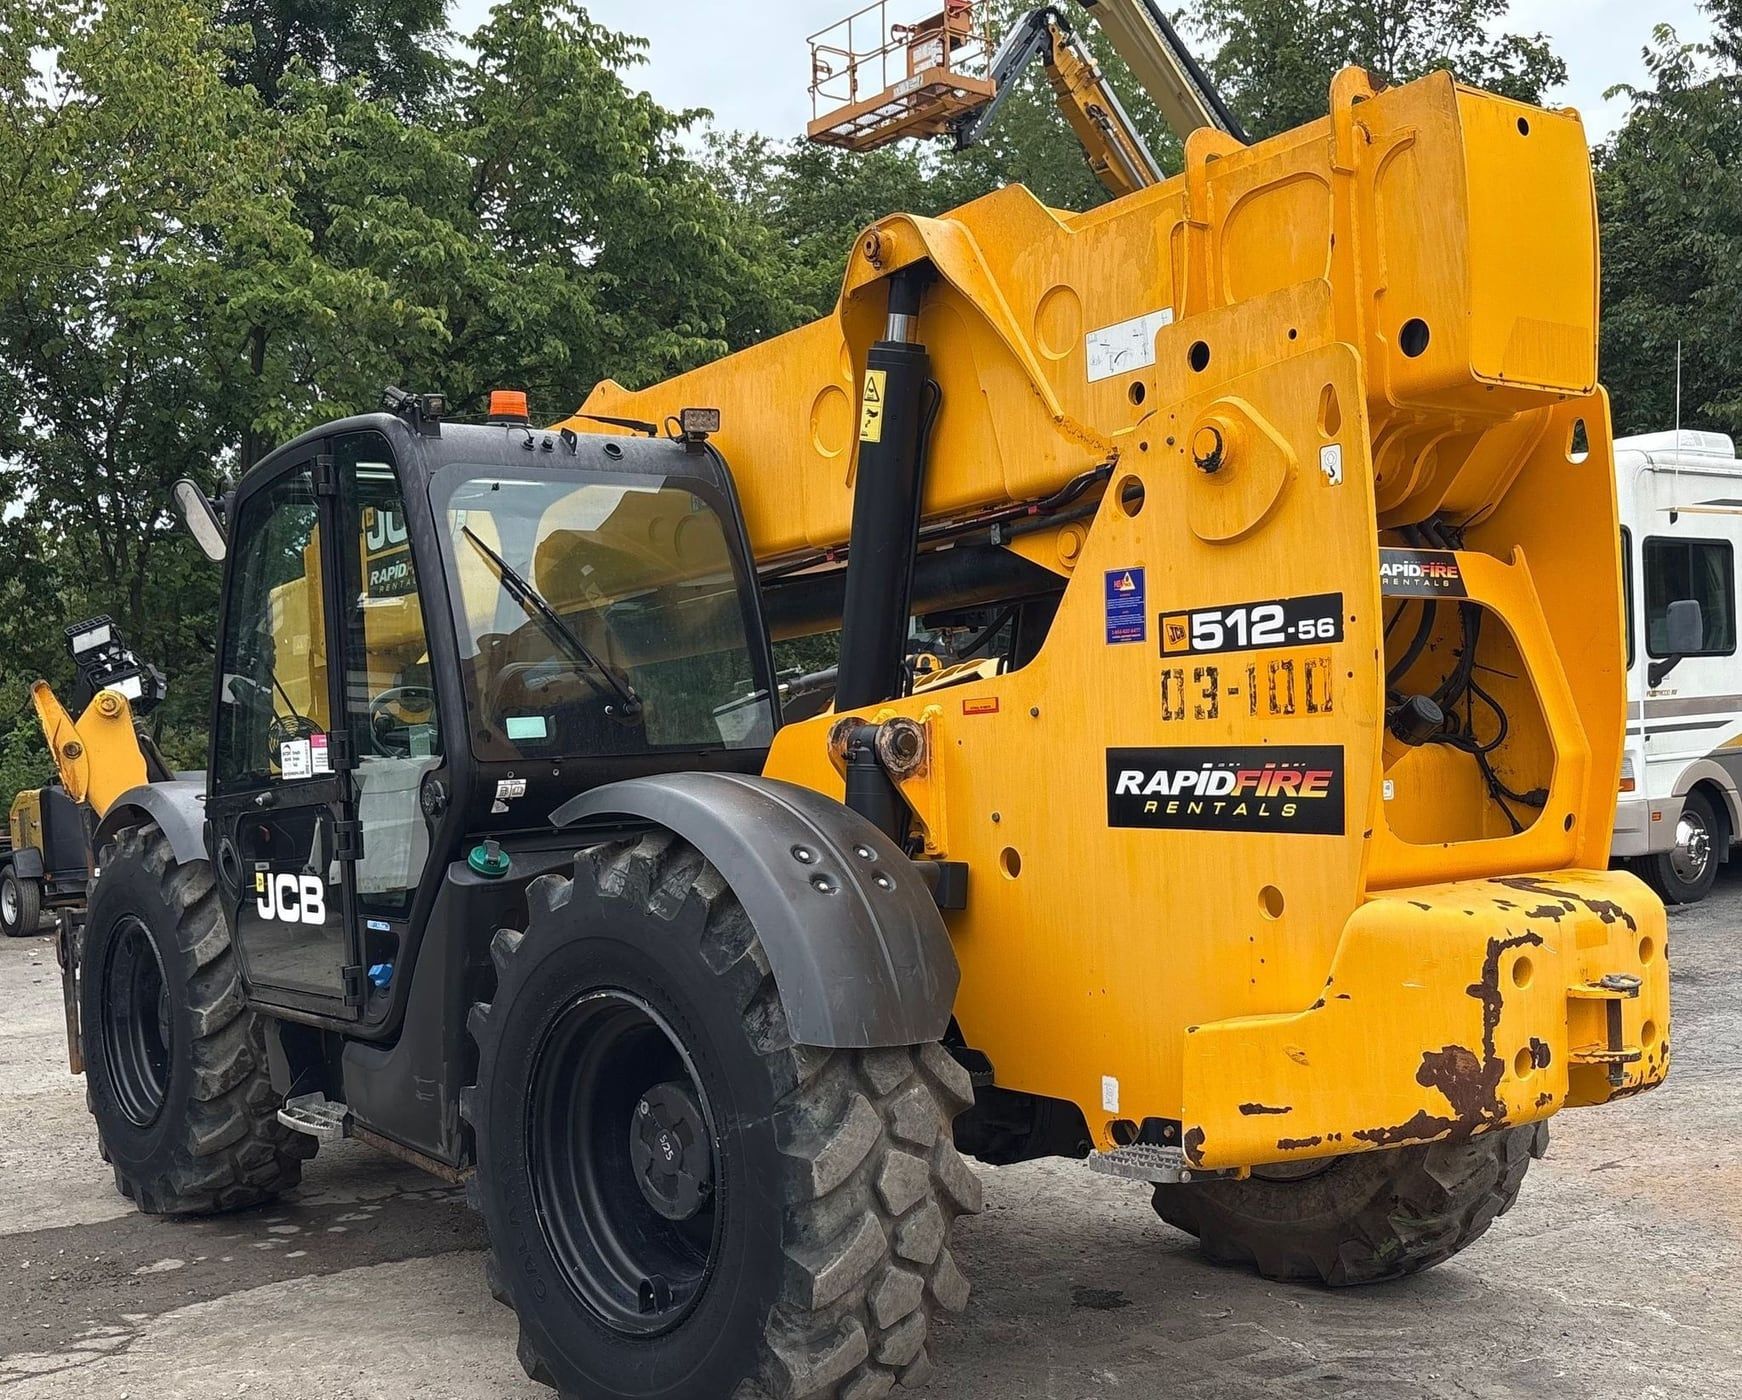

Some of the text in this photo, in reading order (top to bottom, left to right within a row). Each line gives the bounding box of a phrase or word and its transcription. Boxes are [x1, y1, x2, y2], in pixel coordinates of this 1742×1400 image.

[1380, 560, 1459, 579] APIDFIRE
[1382, 578, 1450, 588] RENTALS
[1192, 604, 1335, 650] 512-56
[1160, 657, 1333, 721] 03-100
[1114, 762, 1334, 798] RAPIDFIRE
[1144, 800, 1297, 817] RENTALS
[256, 873, 326, 925] JCB
